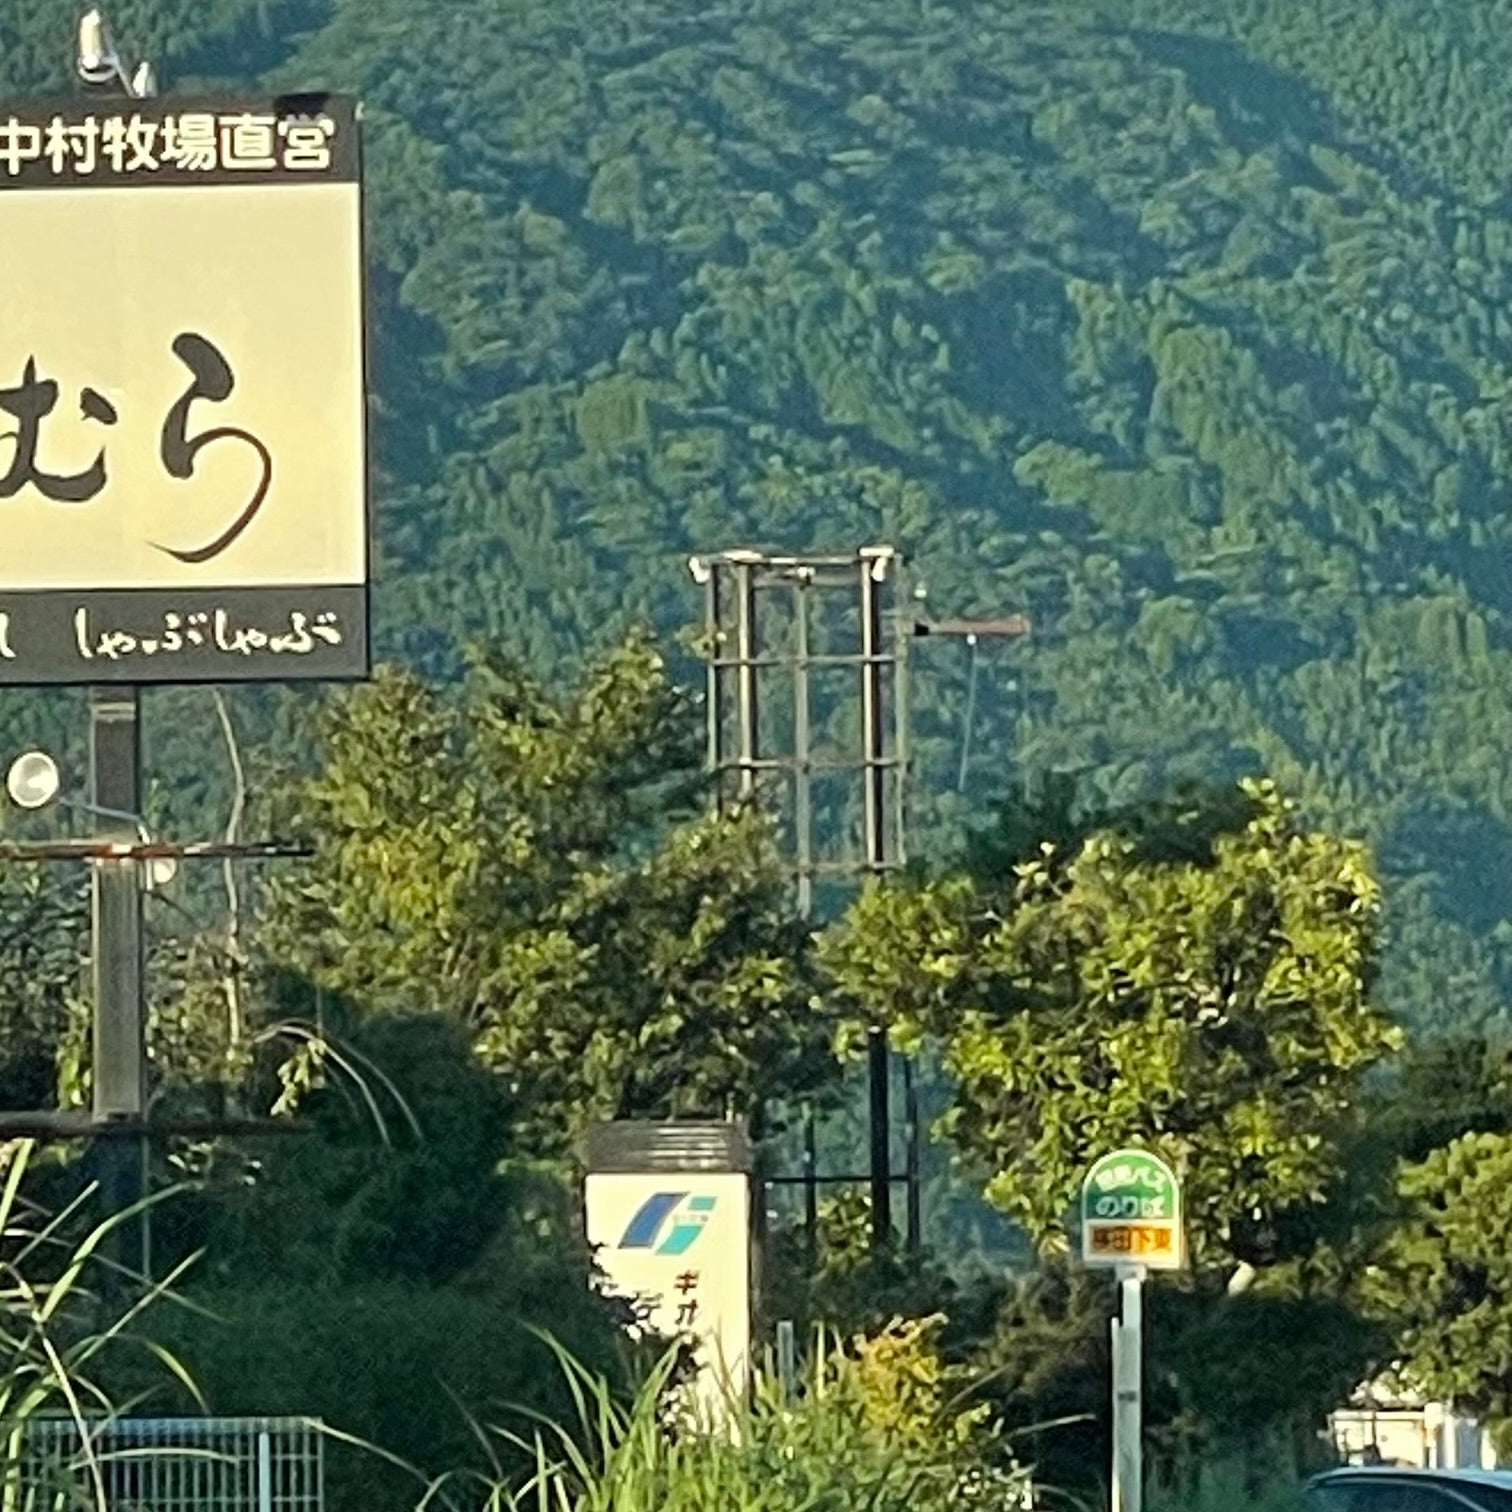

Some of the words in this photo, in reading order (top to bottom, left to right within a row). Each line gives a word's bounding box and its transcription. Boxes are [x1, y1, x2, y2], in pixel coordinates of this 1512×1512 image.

[74, 607, 343, 659] しゃぶしゃぶ
